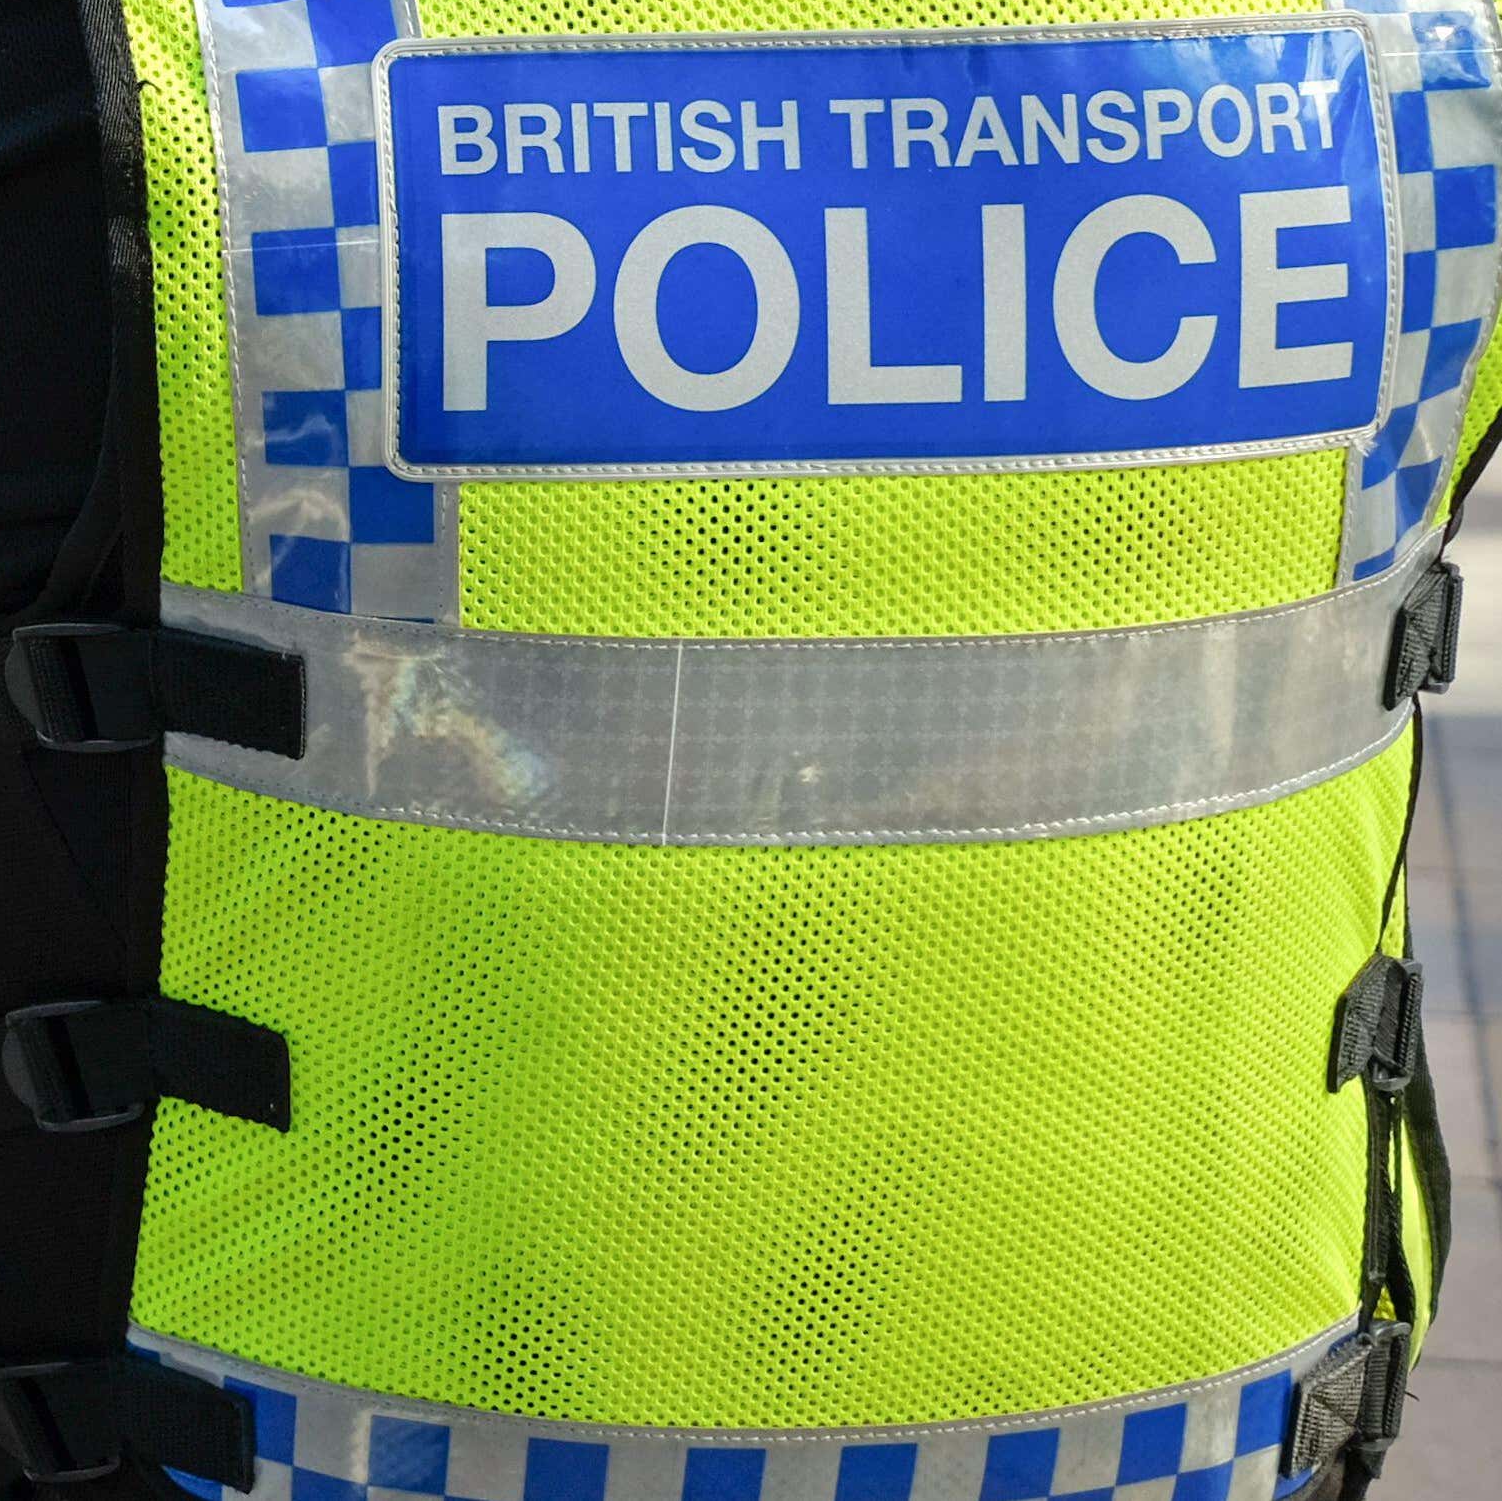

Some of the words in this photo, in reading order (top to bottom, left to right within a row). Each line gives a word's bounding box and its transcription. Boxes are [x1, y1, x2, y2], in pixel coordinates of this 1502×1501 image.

[439, 99, 801, 175] BRITISH
[829, 78, 1340, 169] TRANSPORT
[440, 185, 1355, 413] POLICE
